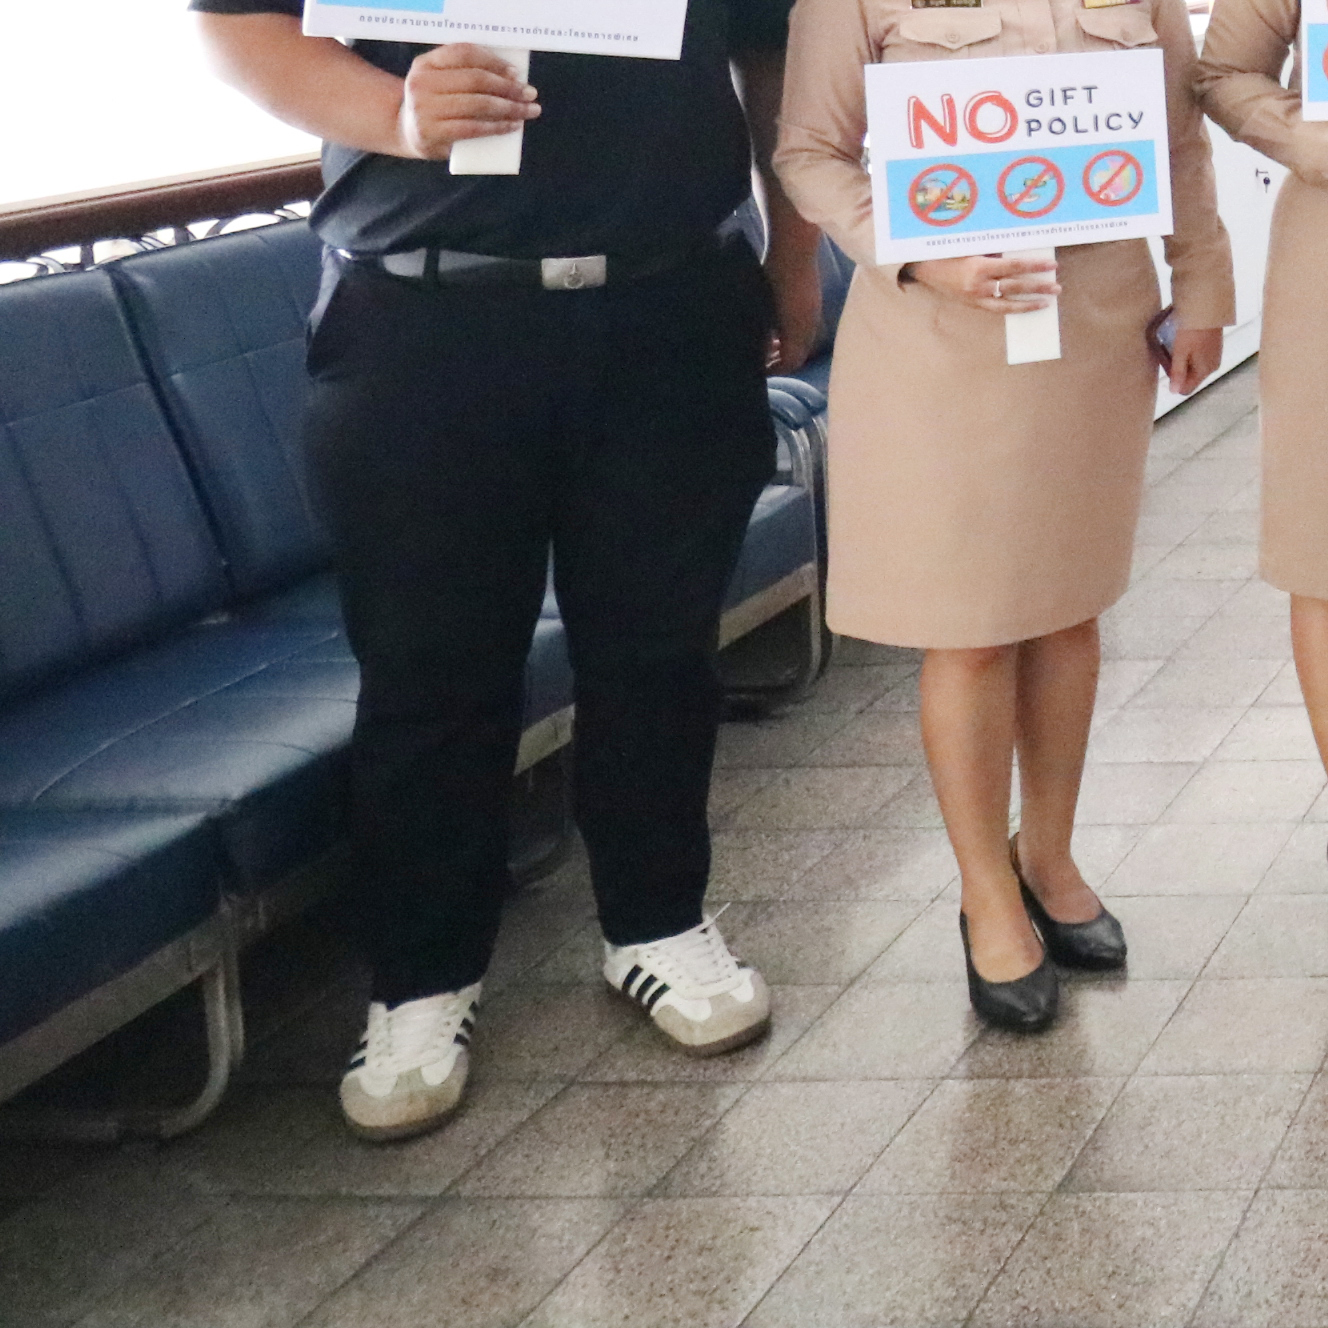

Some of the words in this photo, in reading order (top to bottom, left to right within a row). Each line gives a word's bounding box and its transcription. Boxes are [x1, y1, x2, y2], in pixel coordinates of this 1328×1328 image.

[1025, 84, 1099, 109] GIFT
[907, 89, 1019, 150] NO
[1025, 110, 1144, 138] POLICY
